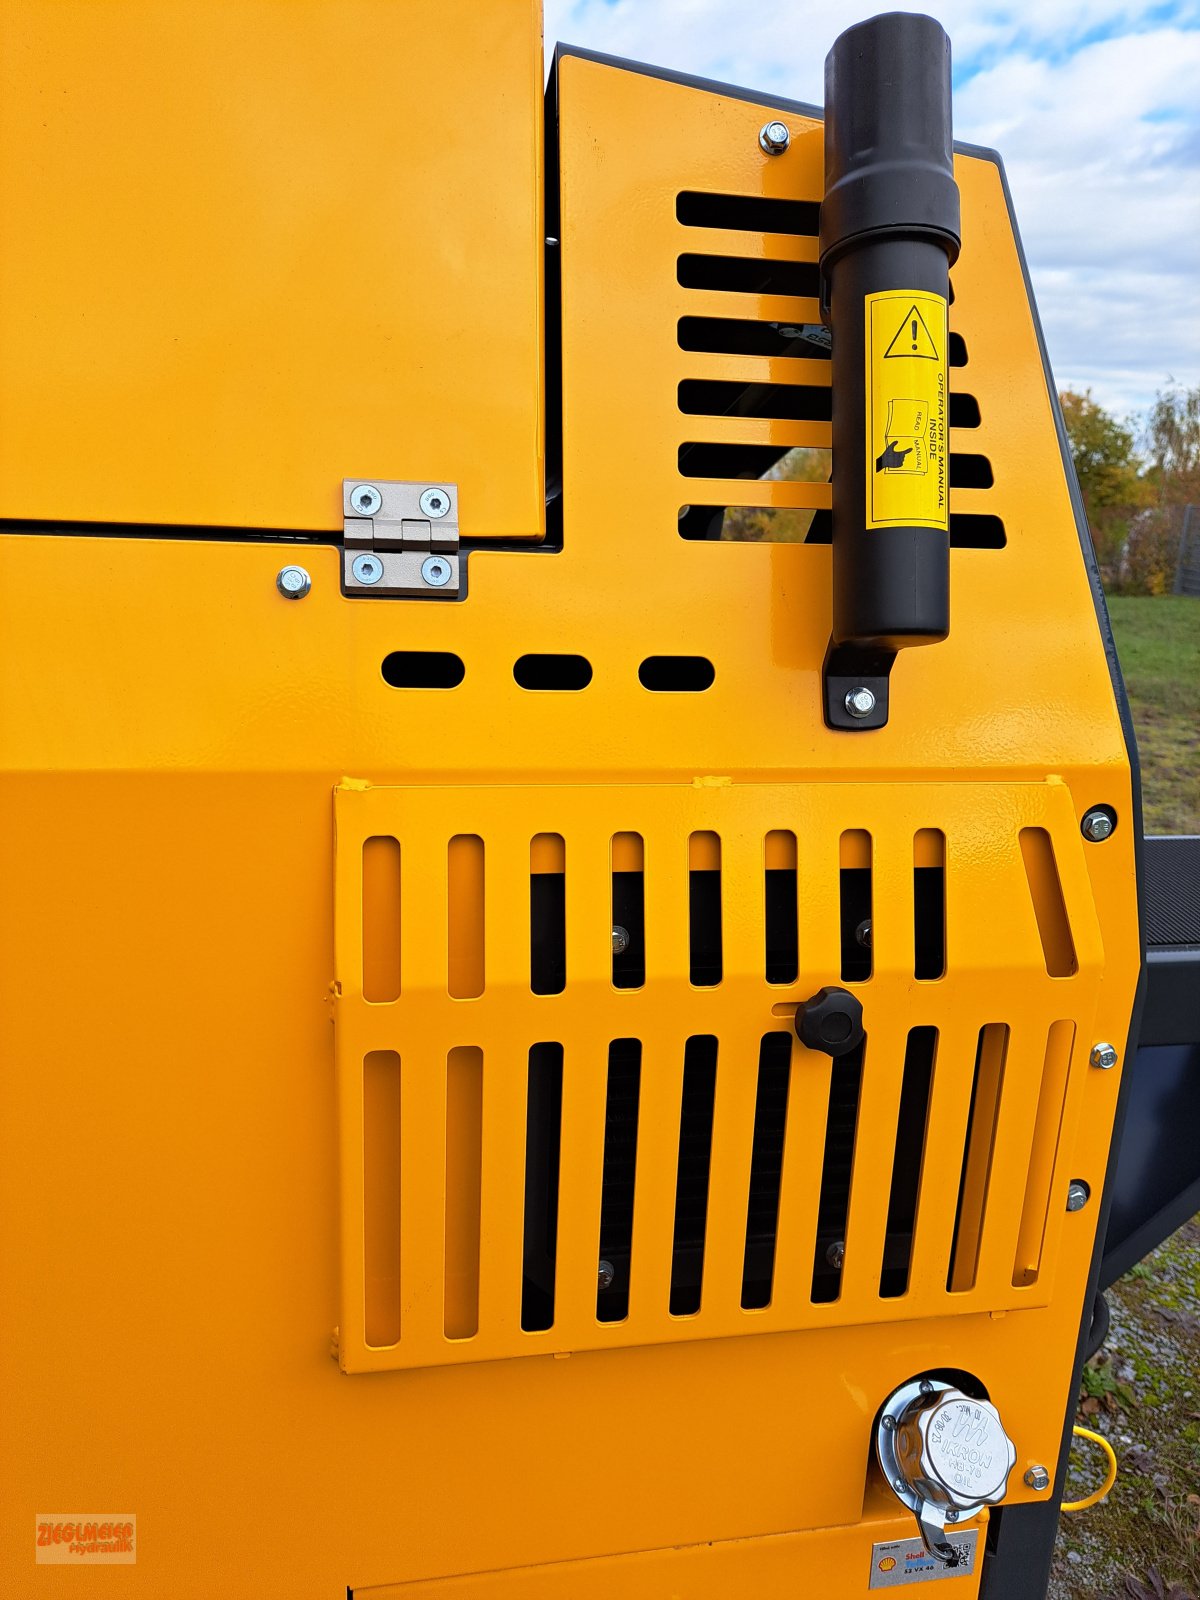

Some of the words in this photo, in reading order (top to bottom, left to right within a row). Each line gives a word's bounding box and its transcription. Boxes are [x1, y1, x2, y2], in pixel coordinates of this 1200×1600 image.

[914, 411, 922, 431] READ
[929, 418, 937, 460] INSIDE
[914, 440, 922, 469] MANUAL
[941, 1439, 992, 1469] IKRON
[954, 1474, 972, 1488] OIL
[905, 1551, 925, 1560] Shell
